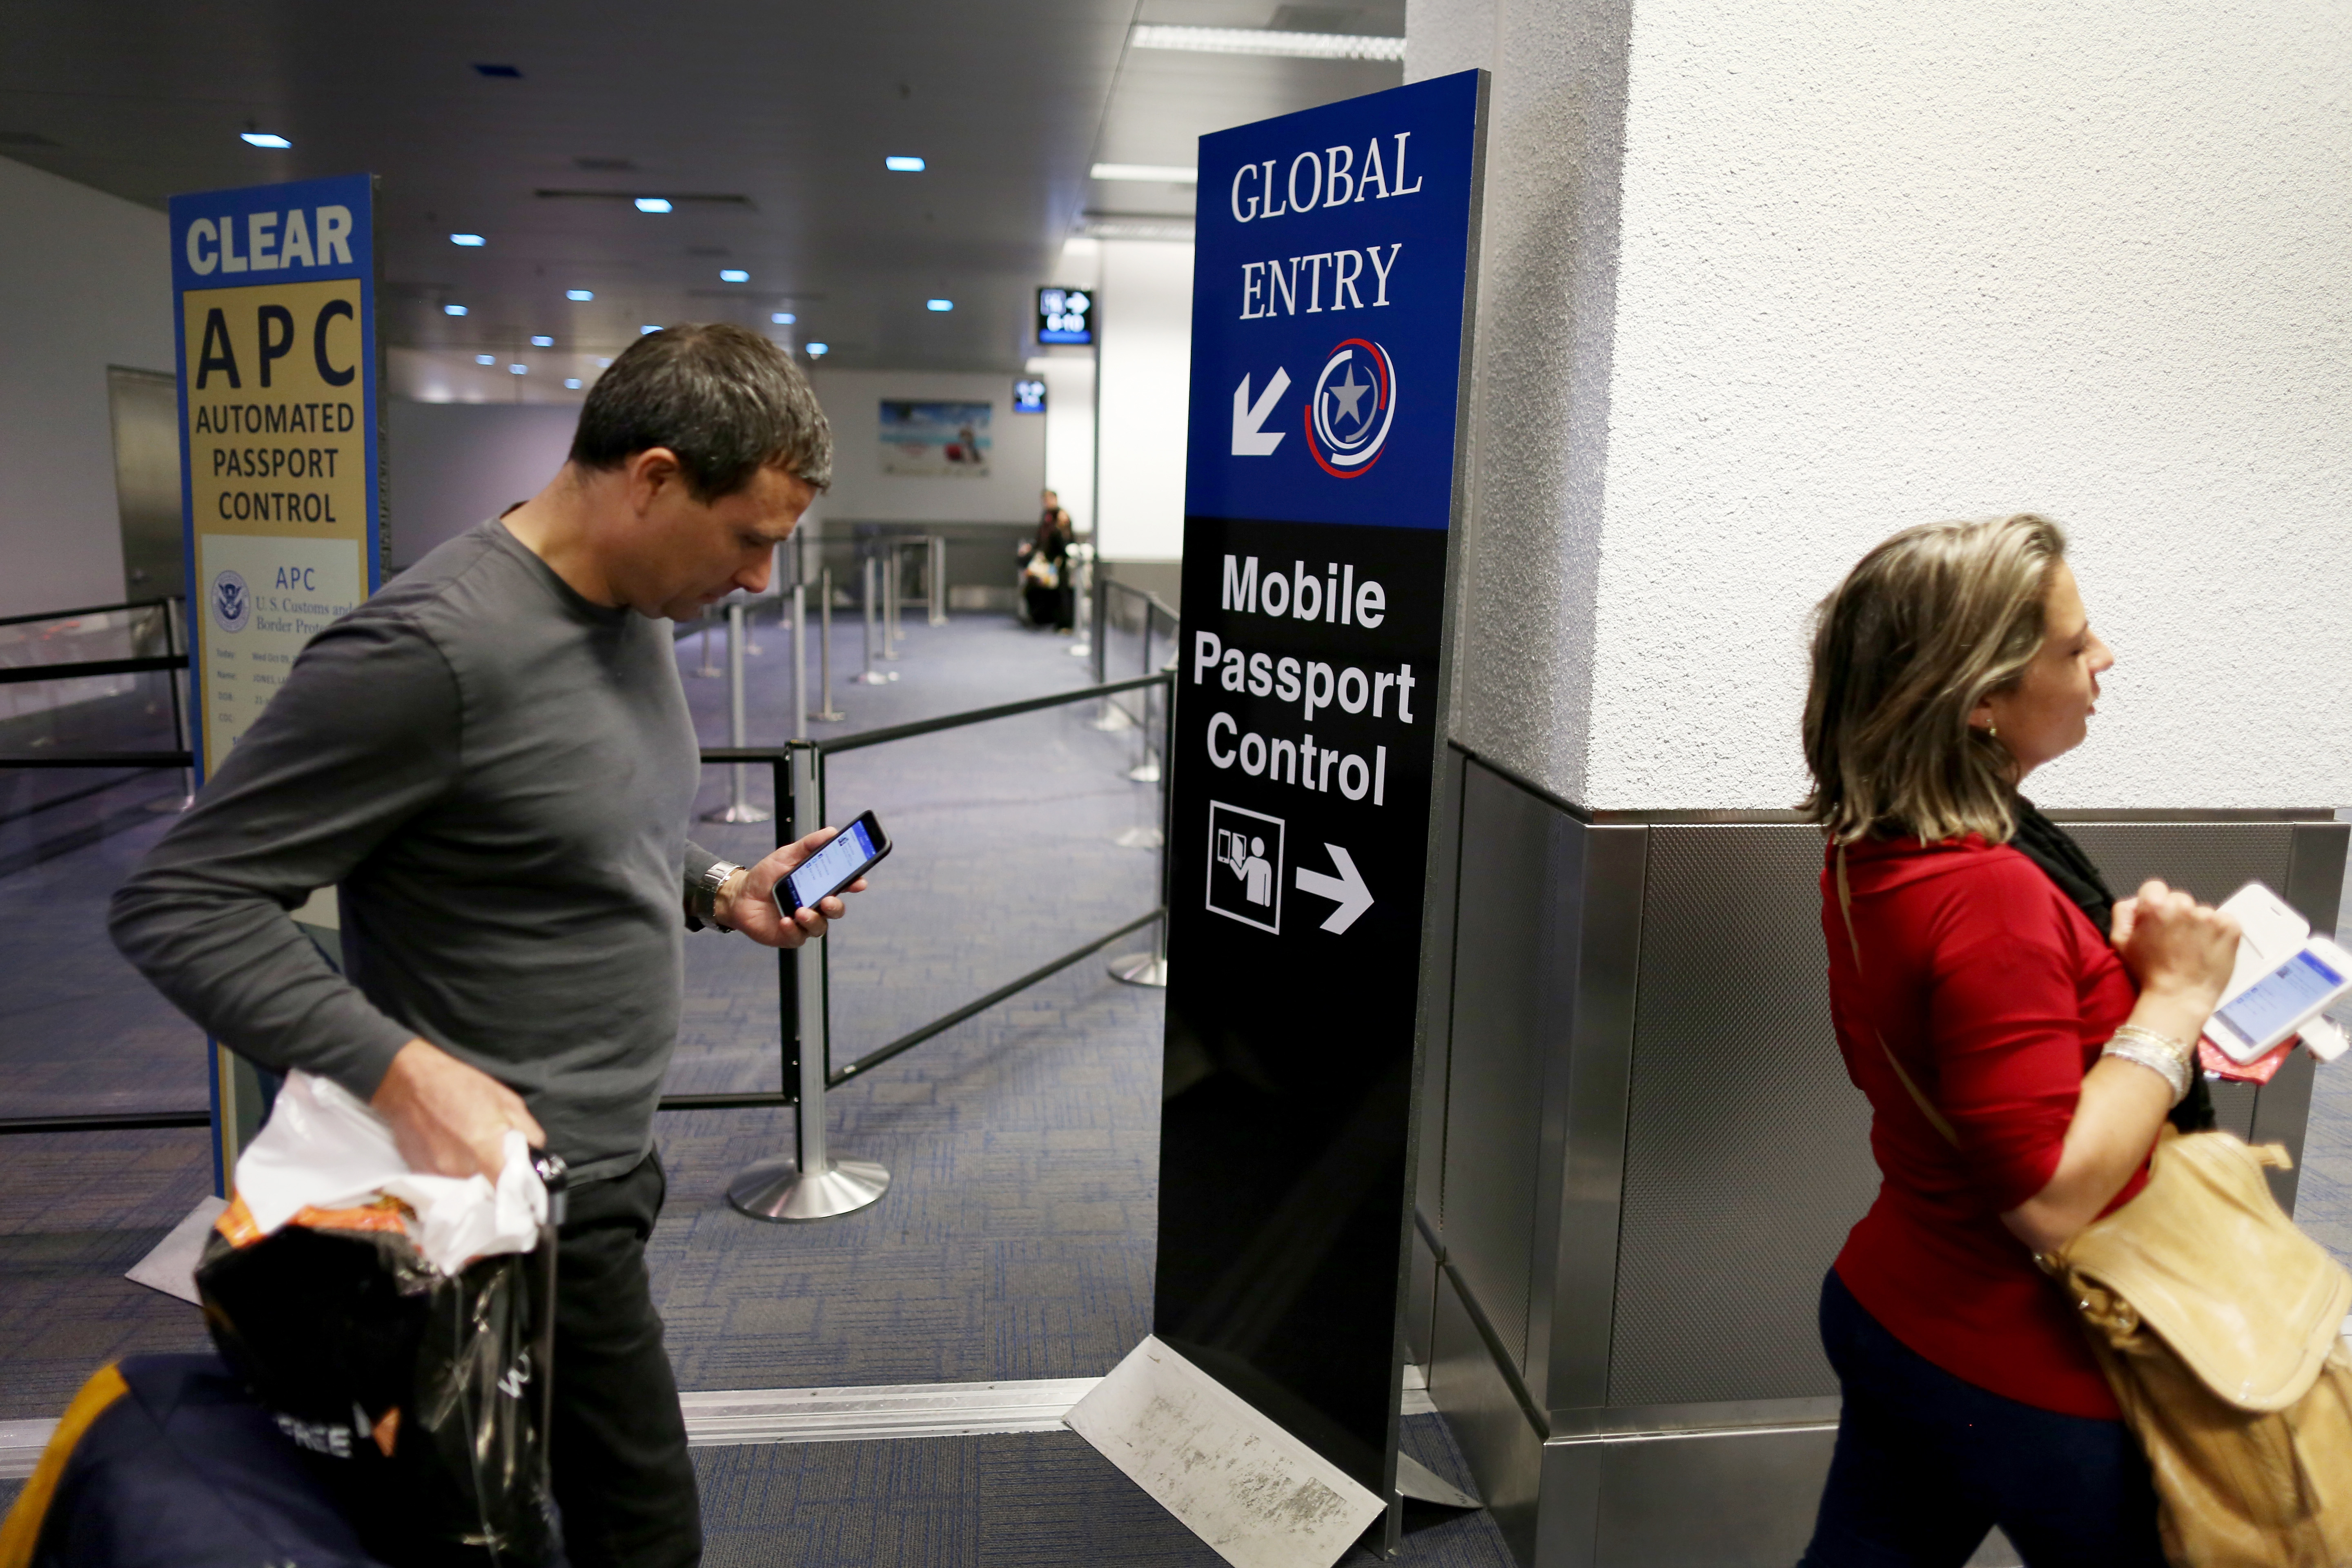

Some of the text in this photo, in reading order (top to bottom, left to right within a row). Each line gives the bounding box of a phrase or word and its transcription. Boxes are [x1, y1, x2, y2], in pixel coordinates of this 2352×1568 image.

[1231, 131, 1423, 223] GLOBAL
[186, 205, 354, 276] CLEAR
[1239, 243, 1402, 320] ENTRY
[195, 298, 355, 391] APC
[195, 402, 354, 434] AUTOMATED
[212, 447, 339, 479] PASSPORT
[218, 490, 336, 523] CONTROL
[275, 566, 315, 592] APC
[282, 598, 329, 614] Customs
[1222, 554, 1386, 629] Mobile
[256, 615, 292, 633] Border
[1194, 630, 1416, 724] Passport
[1207, 711, 1387, 806] Control
